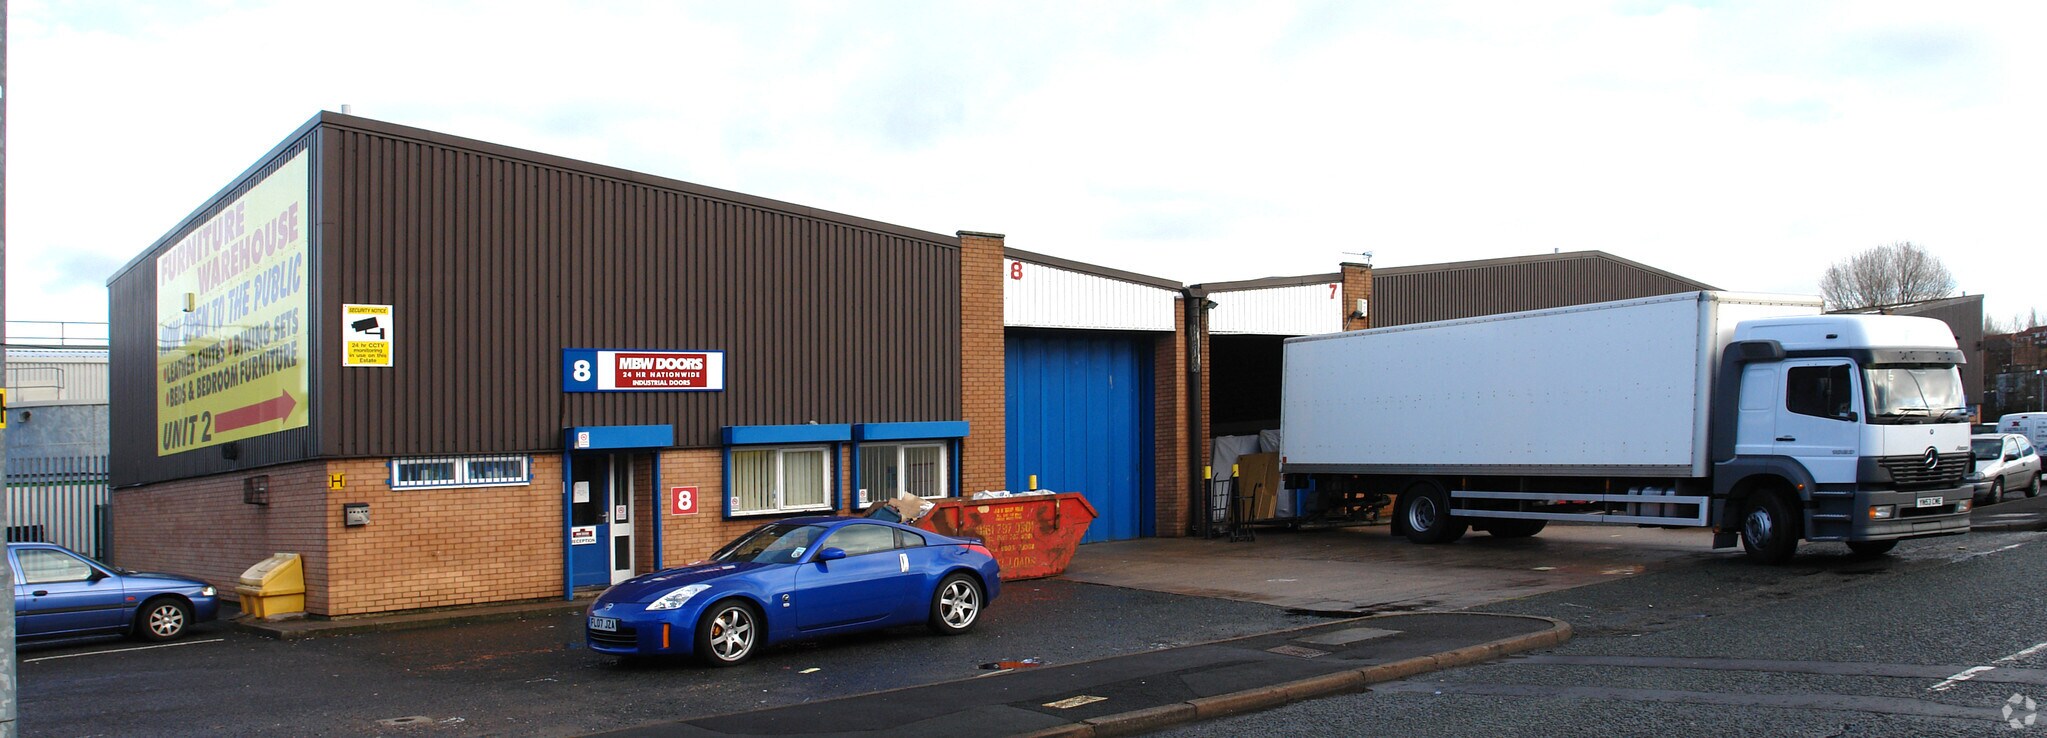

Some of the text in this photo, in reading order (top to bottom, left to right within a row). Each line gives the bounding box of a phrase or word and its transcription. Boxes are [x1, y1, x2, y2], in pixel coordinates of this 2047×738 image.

[161, 201, 245, 287] FURNITURE
[197, 201, 299, 297] WAREHOUSE
[1010, 261, 1023, 280] 8
[182, 302, 209, 345] OPEN
[212, 295, 225, 332] TO
[228, 280, 250, 324] THE
[254, 252, 302, 312] PUBLIC
[1329, 284, 1338, 299] 7
[233, 307, 299, 357] DINING SETS
[166, 340, 225, 384] LEATHER SUITES
[169, 340, 297, 407] BEDS & BEDROOM FURNITURE
[573, 359, 592, 382] 8
[619, 357, 703, 370] MBW DOORS
[163, 410, 212, 450] UNIT 2
[331, 474, 343, 488] H
[677, 490, 693, 511] 8
